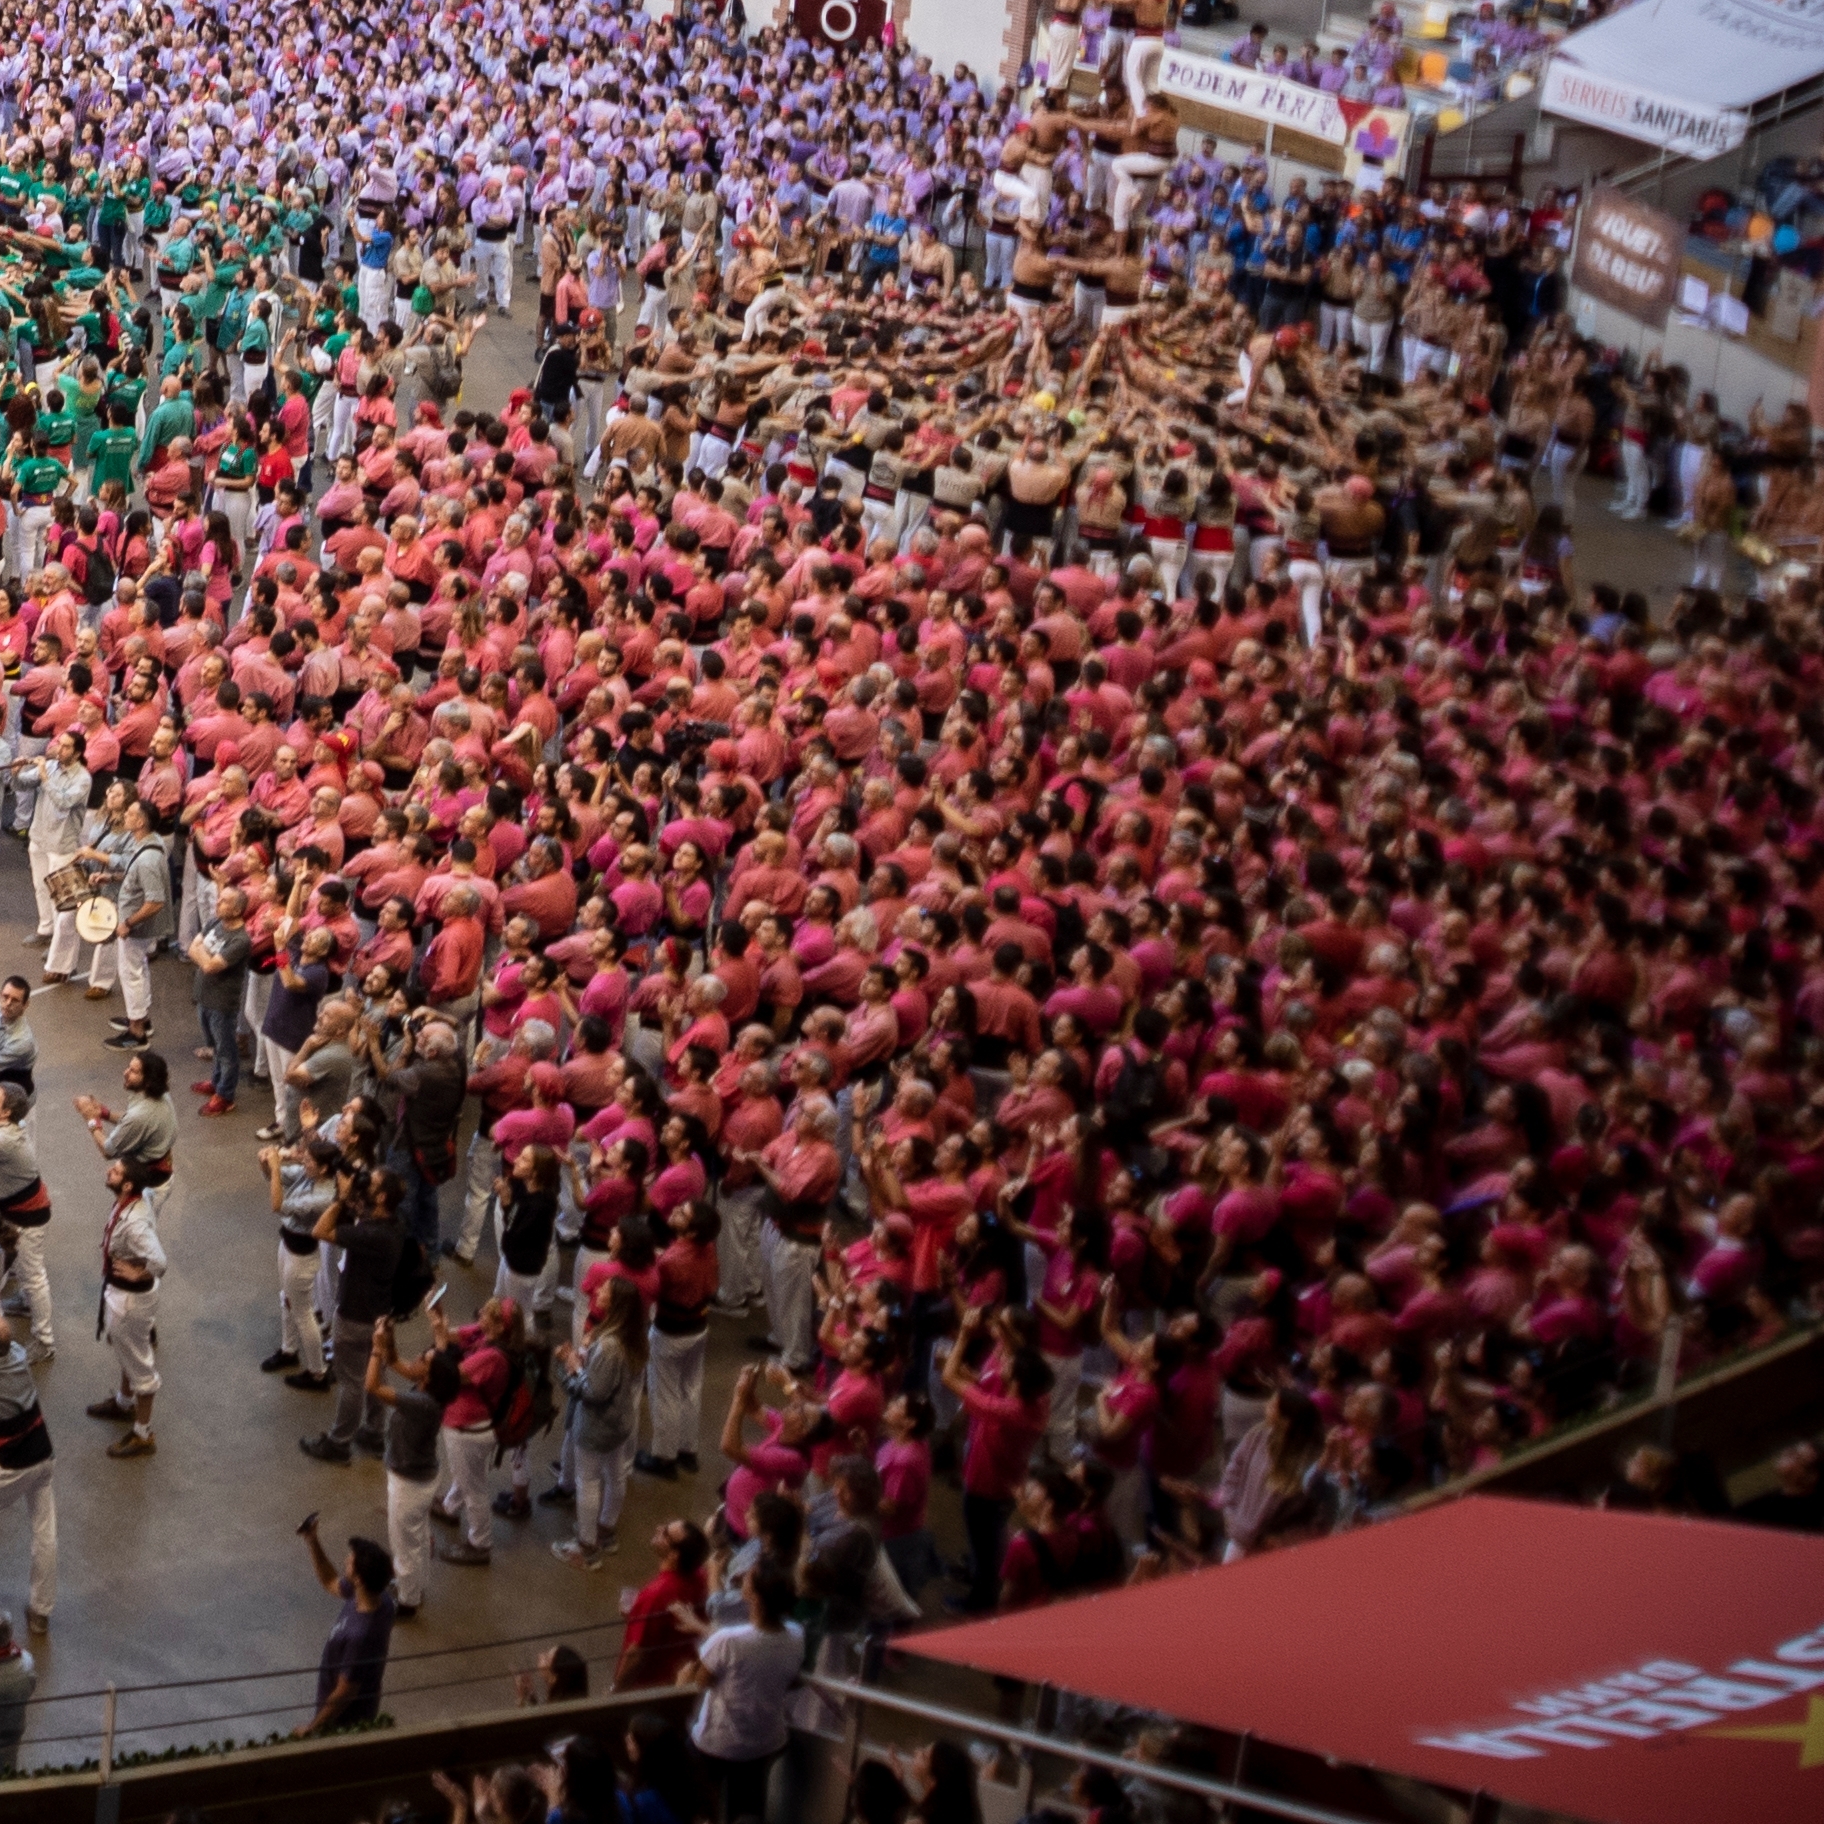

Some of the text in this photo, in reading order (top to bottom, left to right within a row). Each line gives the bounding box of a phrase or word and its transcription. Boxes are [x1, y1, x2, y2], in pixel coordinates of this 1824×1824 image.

[1168, 60, 1247, 103] PODEM
[1560, 78, 1728, 153] SERVEIS SANITARIS
[1509, 1658, 1702, 1716] DAMM
